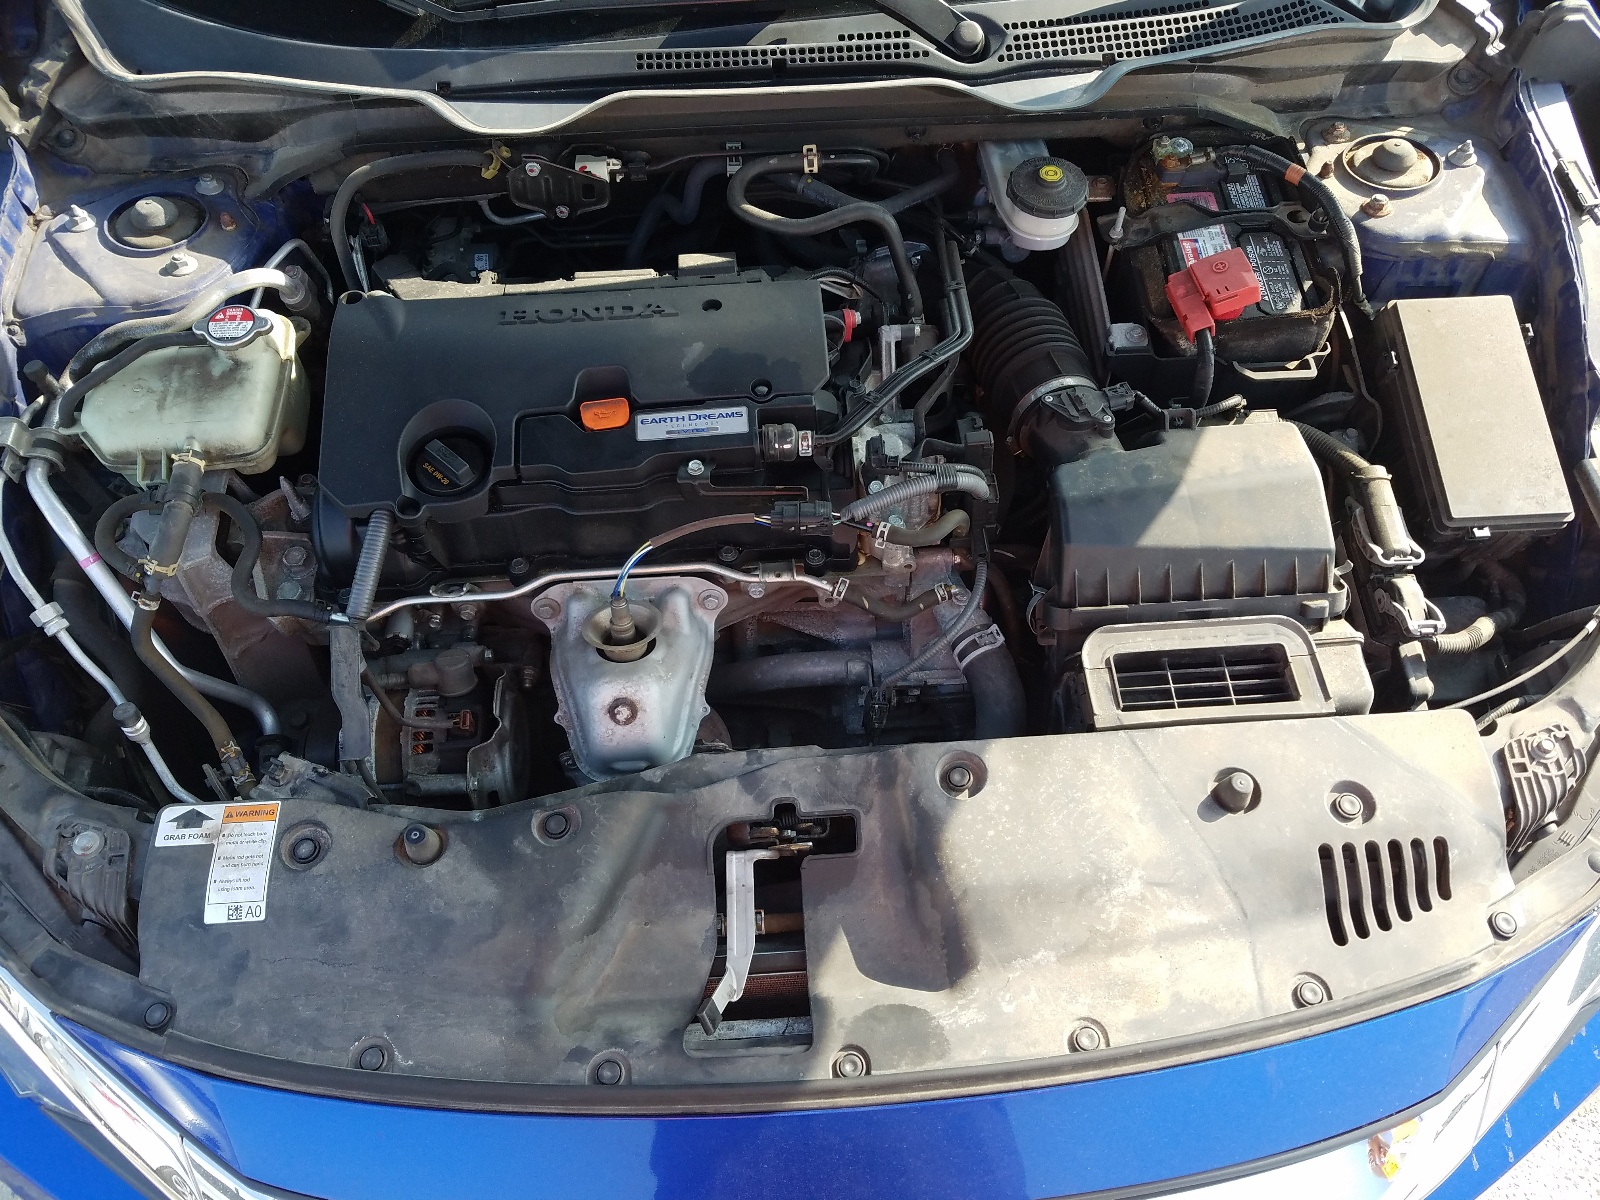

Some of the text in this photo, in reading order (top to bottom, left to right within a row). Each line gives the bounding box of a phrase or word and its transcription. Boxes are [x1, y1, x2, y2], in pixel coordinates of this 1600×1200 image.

[1246, 245, 1258, 267] POISON
[499, 303, 680, 325] HONDA
[640, 411, 744, 425] EARTH DREAMS
[422, 462, 436, 474] SAE
[235, 809, 275, 817] WARNING
[164, 832, 211, 841] GRAB FOAM
[245, 904, 262, 919] A0
